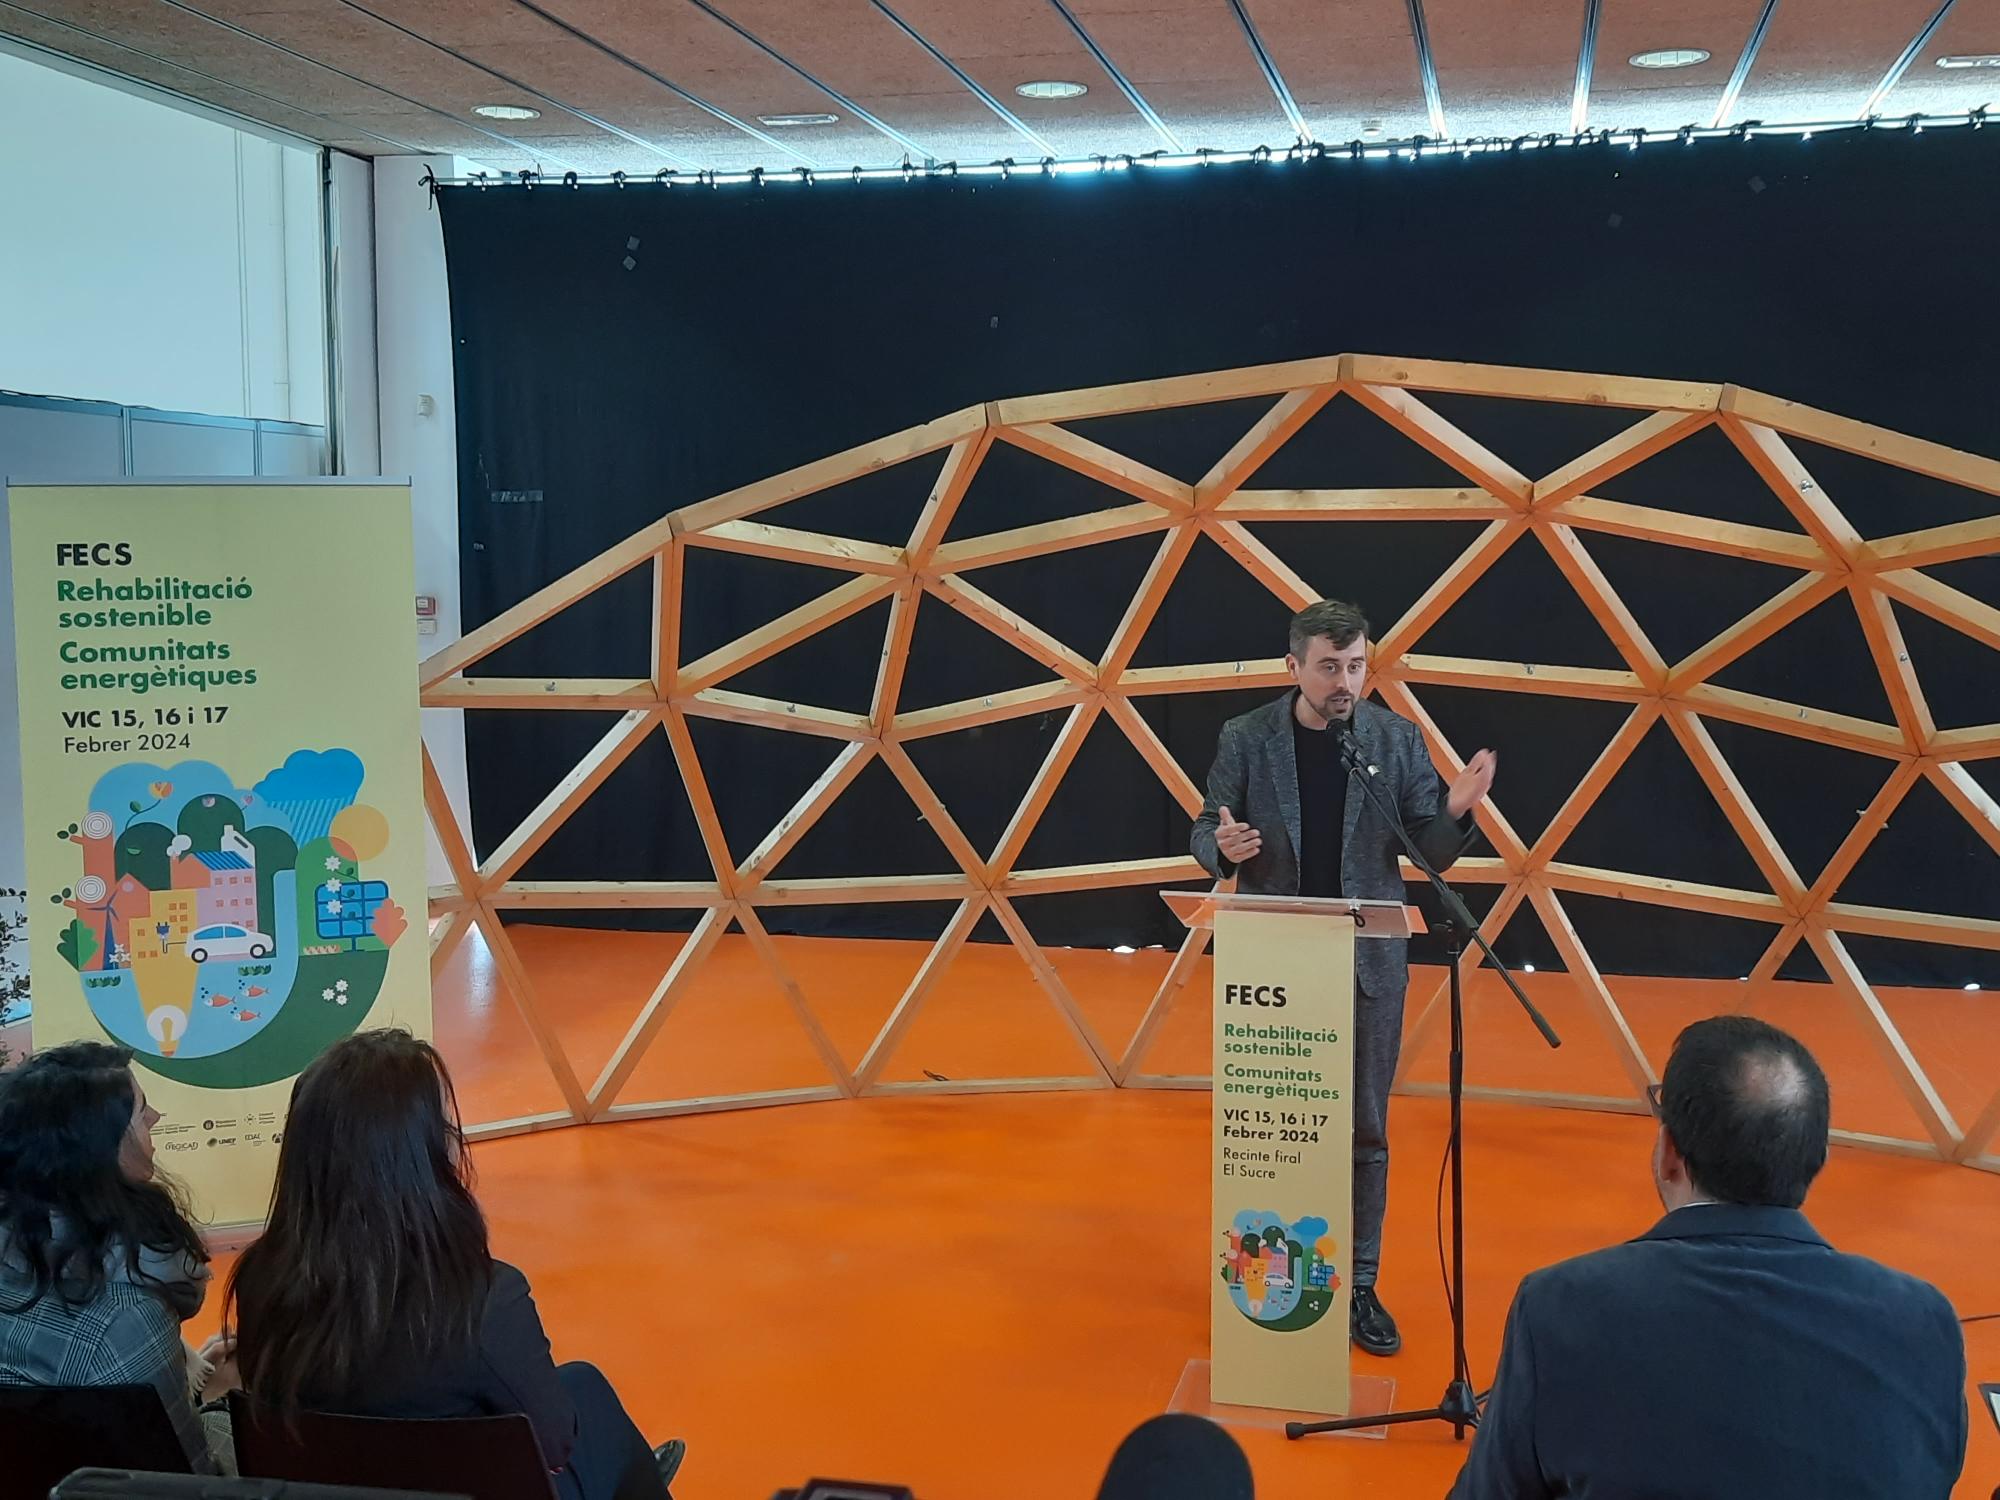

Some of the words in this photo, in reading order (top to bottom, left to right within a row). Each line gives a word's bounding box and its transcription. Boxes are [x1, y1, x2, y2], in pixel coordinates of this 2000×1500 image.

[56, 543, 133, 566] FECS
[57, 576, 253, 602] Rehabilitació
[59, 603, 212, 628] sostenible
[60, 639, 231, 664] Comunitats
[61, 664, 258, 694] energètiques
[62, 711, 101, 729] VIC
[112, 709, 145, 729] 15,
[155, 708, 181, 726] 16
[188, 707, 194, 725] i
[204, 706, 229, 724] 17
[64, 735, 131, 754] Febrer
[138, 733, 191, 751] 2024
[1225, 984, 1287, 1008] FECS
[1224, 1023, 1338, 1043] Rehabilitació
[1224, 1042, 1313, 1058] sostenible
[1224, 1063, 1322, 1083] Comunitats
[1223, 1082, 1340, 1101] energètiques
[1223, 1109, 1249, 1122] VIC
[1255, 1111, 1275, 1125] 15,
[1280, 1112, 1297, 1125] 16
[1301, 1113, 1305, 1125] i
[1312, 1114, 1329, 1127] 17
[1223, 1126, 1274, 1141] Febrer
[1279, 1130, 1320, 1143] 2024
[1223, 1147, 1270, 1162] Recinte
[1275, 1149, 1301, 1164] firal
[1223, 1164, 1234, 1176] El
[1240, 1165, 1276, 1179] Sucre
